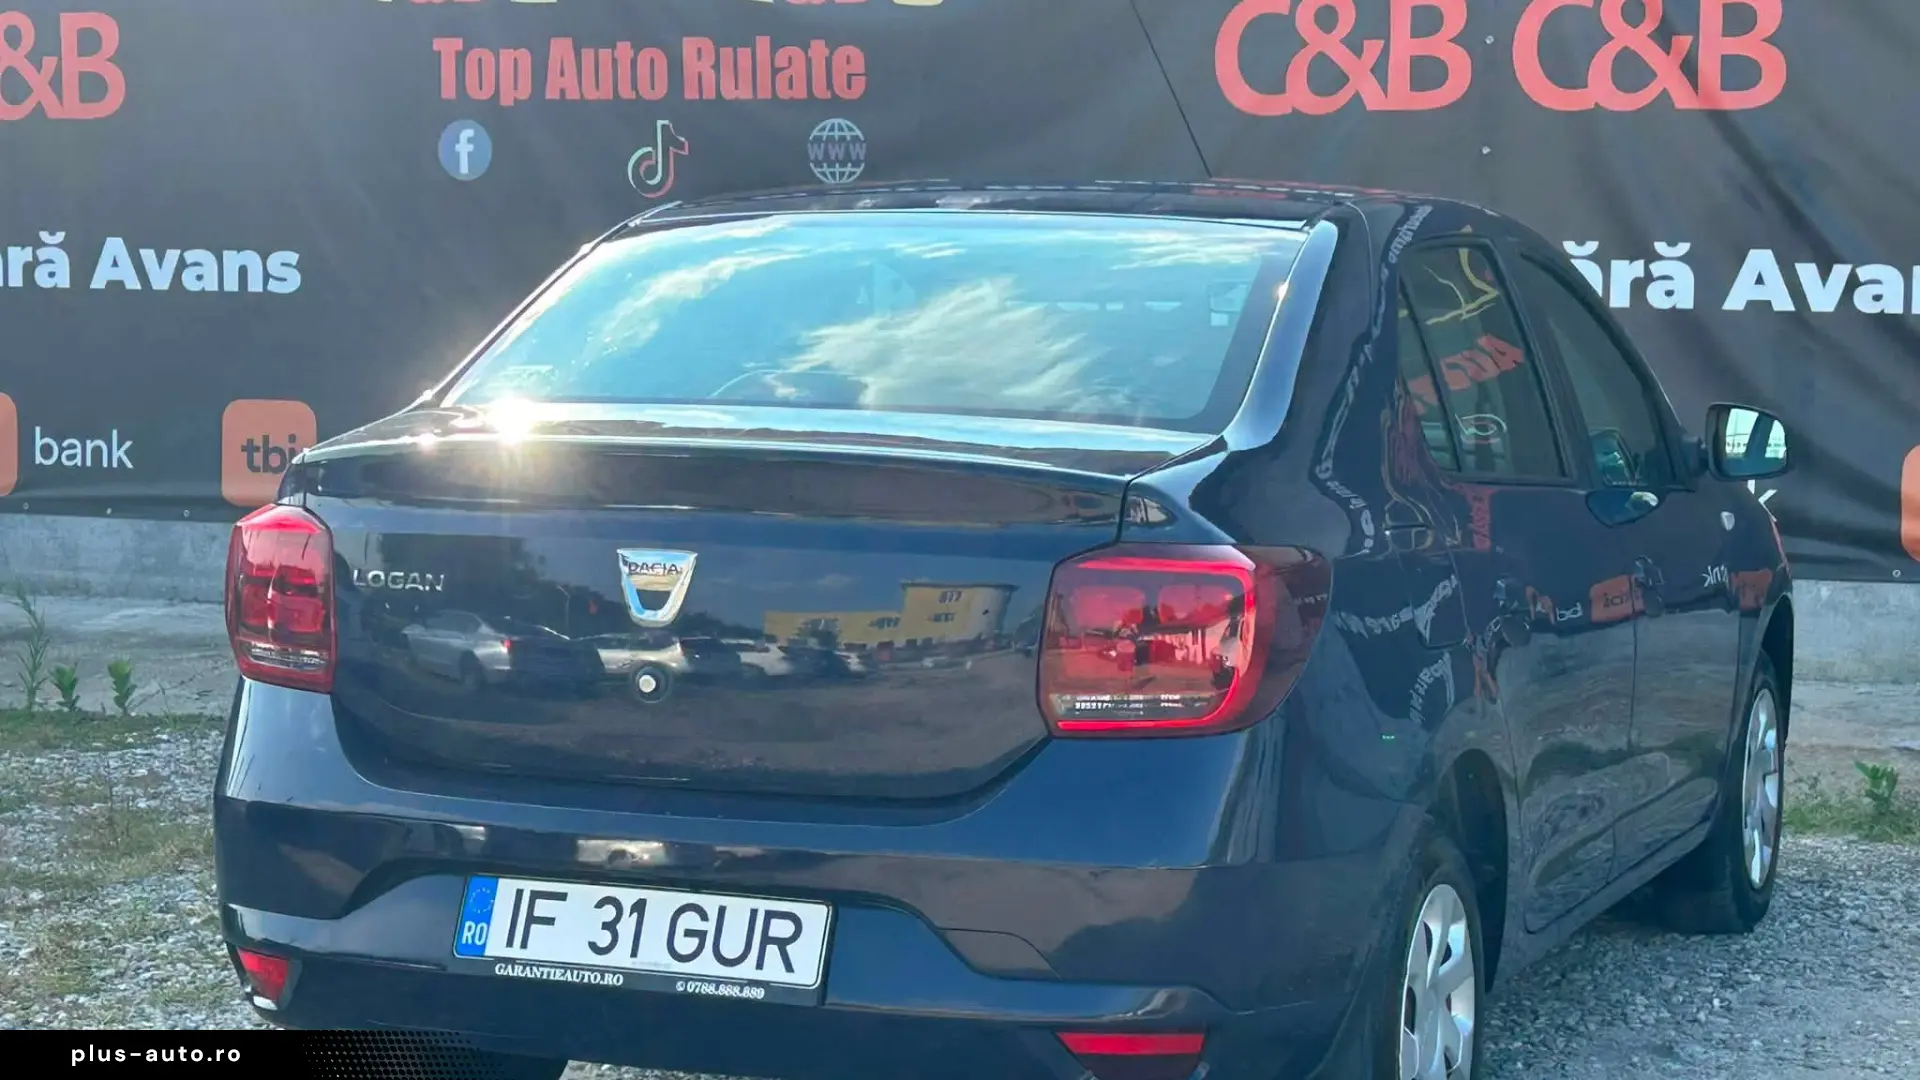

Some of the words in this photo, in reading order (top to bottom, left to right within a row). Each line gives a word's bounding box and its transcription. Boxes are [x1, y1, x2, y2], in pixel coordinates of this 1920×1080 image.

[433, 37, 532, 105] Top
[545, 37, 668, 100] Auto
[682, 35, 867, 100] Rulate
[1215, 0, 1471, 116] C&B
[1512, 0, 1787, 111] C&B
[0, 231, 70, 288] ră
[90, 237, 301, 293] Avans
[1721, 248, 1920, 315] Ava
[34, 426, 133, 469] bank
[353, 569, 444, 591] LOGAN
[628, 562, 679, 574] DACIA
[461, 920, 487, 945] RO
[506, 888, 568, 949] IF
[588, 896, 647, 958] 31
[666, 902, 803, 973] GUR
[494, 963, 624, 986] GARANTIEAUTO.RO
